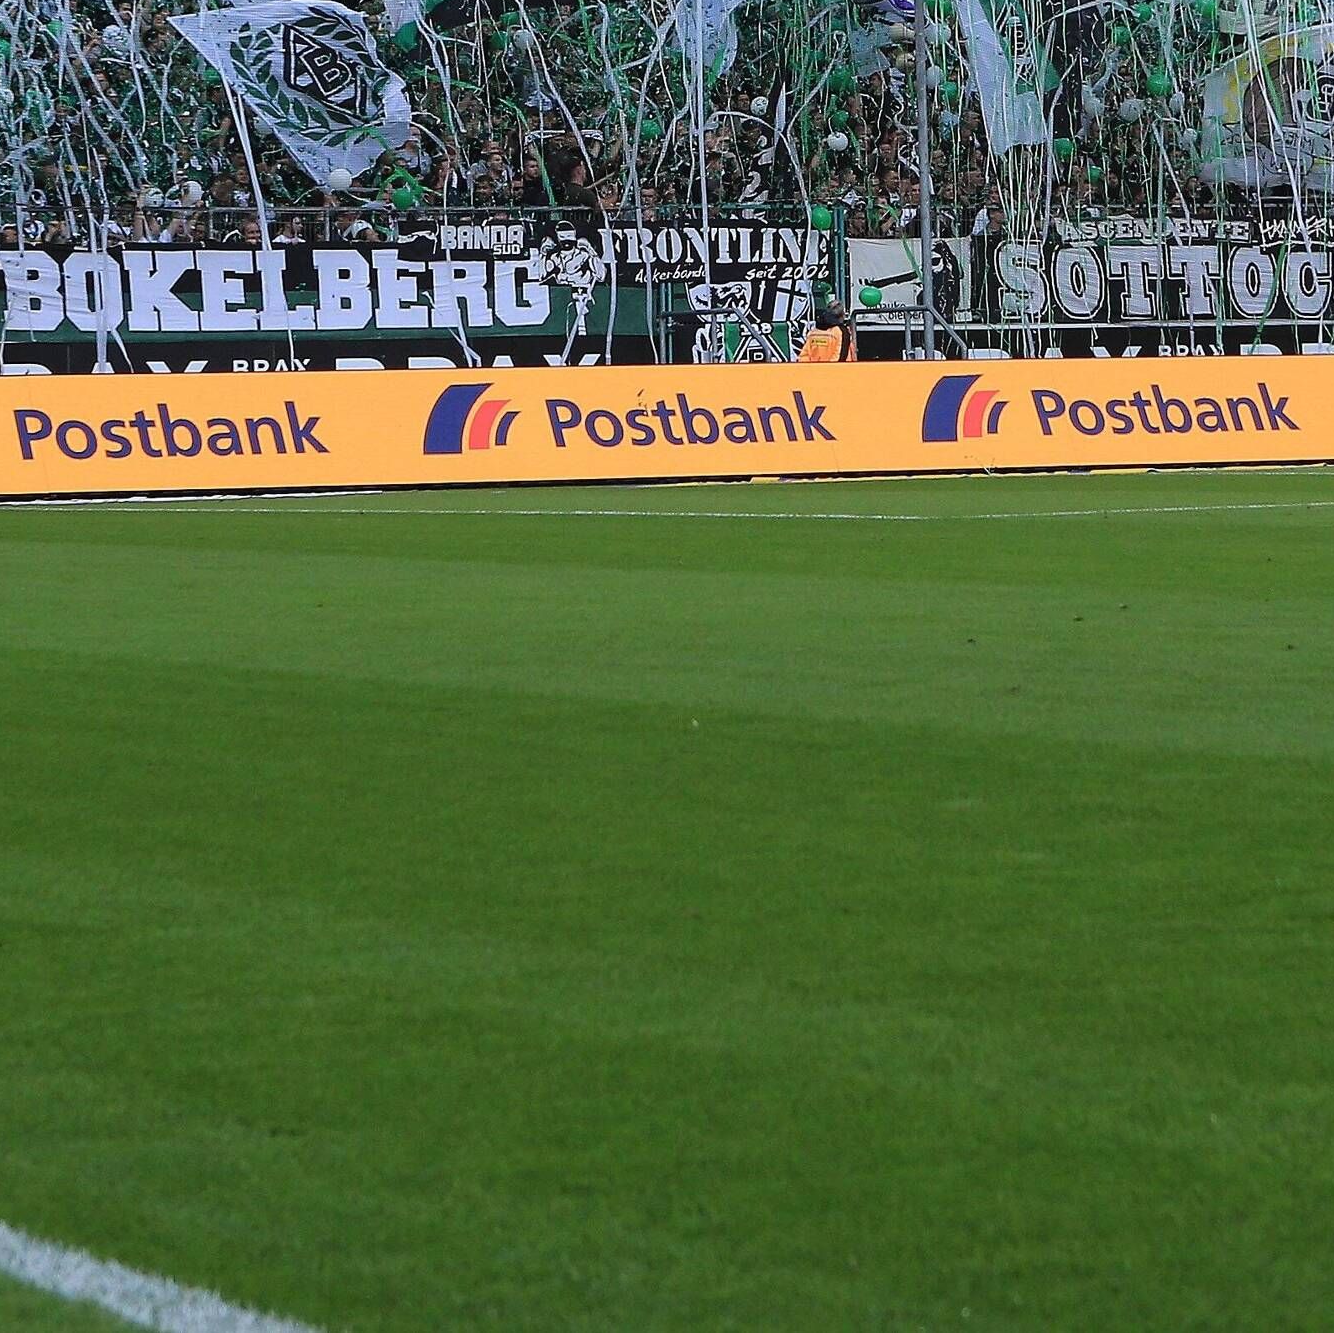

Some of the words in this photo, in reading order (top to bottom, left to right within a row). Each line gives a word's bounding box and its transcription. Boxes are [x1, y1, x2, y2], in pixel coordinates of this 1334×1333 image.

[440, 225, 525, 250] BANDA
[598, 227, 830, 265] FRONTLINE
[745, 264, 776, 280] seit
[782, 264, 829, 281] 2006
[14, 400, 329, 460] Postbank
[545, 390, 837, 447] Postbank
[1031, 383, 1300, 435] Postbank
